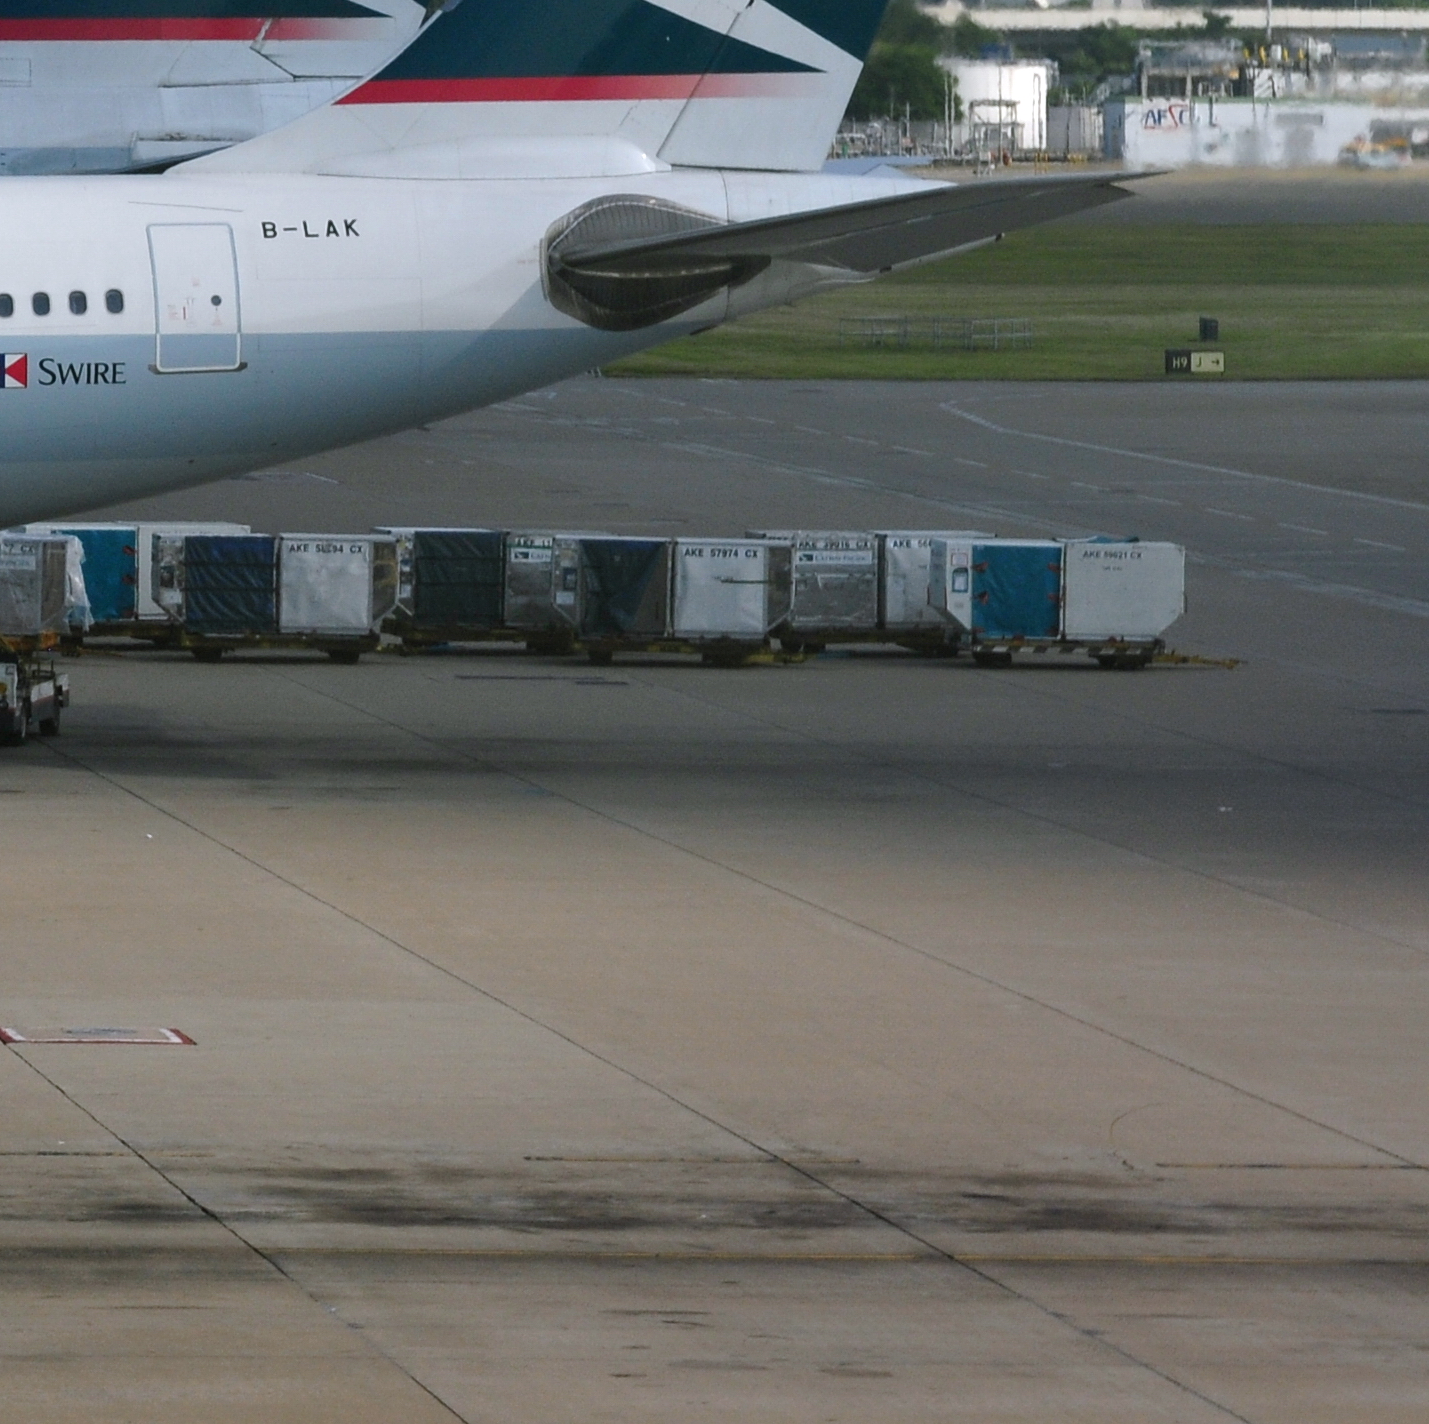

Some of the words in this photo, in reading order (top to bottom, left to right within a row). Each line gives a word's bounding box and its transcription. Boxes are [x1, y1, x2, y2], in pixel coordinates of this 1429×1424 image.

[261, 219, 360, 239] B-LAK
[1172, 356, 1188, 369] H9
[289, 543, 310, 553] AKE
[349, 544, 363, 554] CX
[893, 539, 912, 549] AKE
[684, 547, 704, 557] AKE
[710, 547, 740, 558] 57974
[744, 548, 758, 558] CX
[1082, 550, 1101, 559] AKE
[1130, 551, 1142, 560] CX
